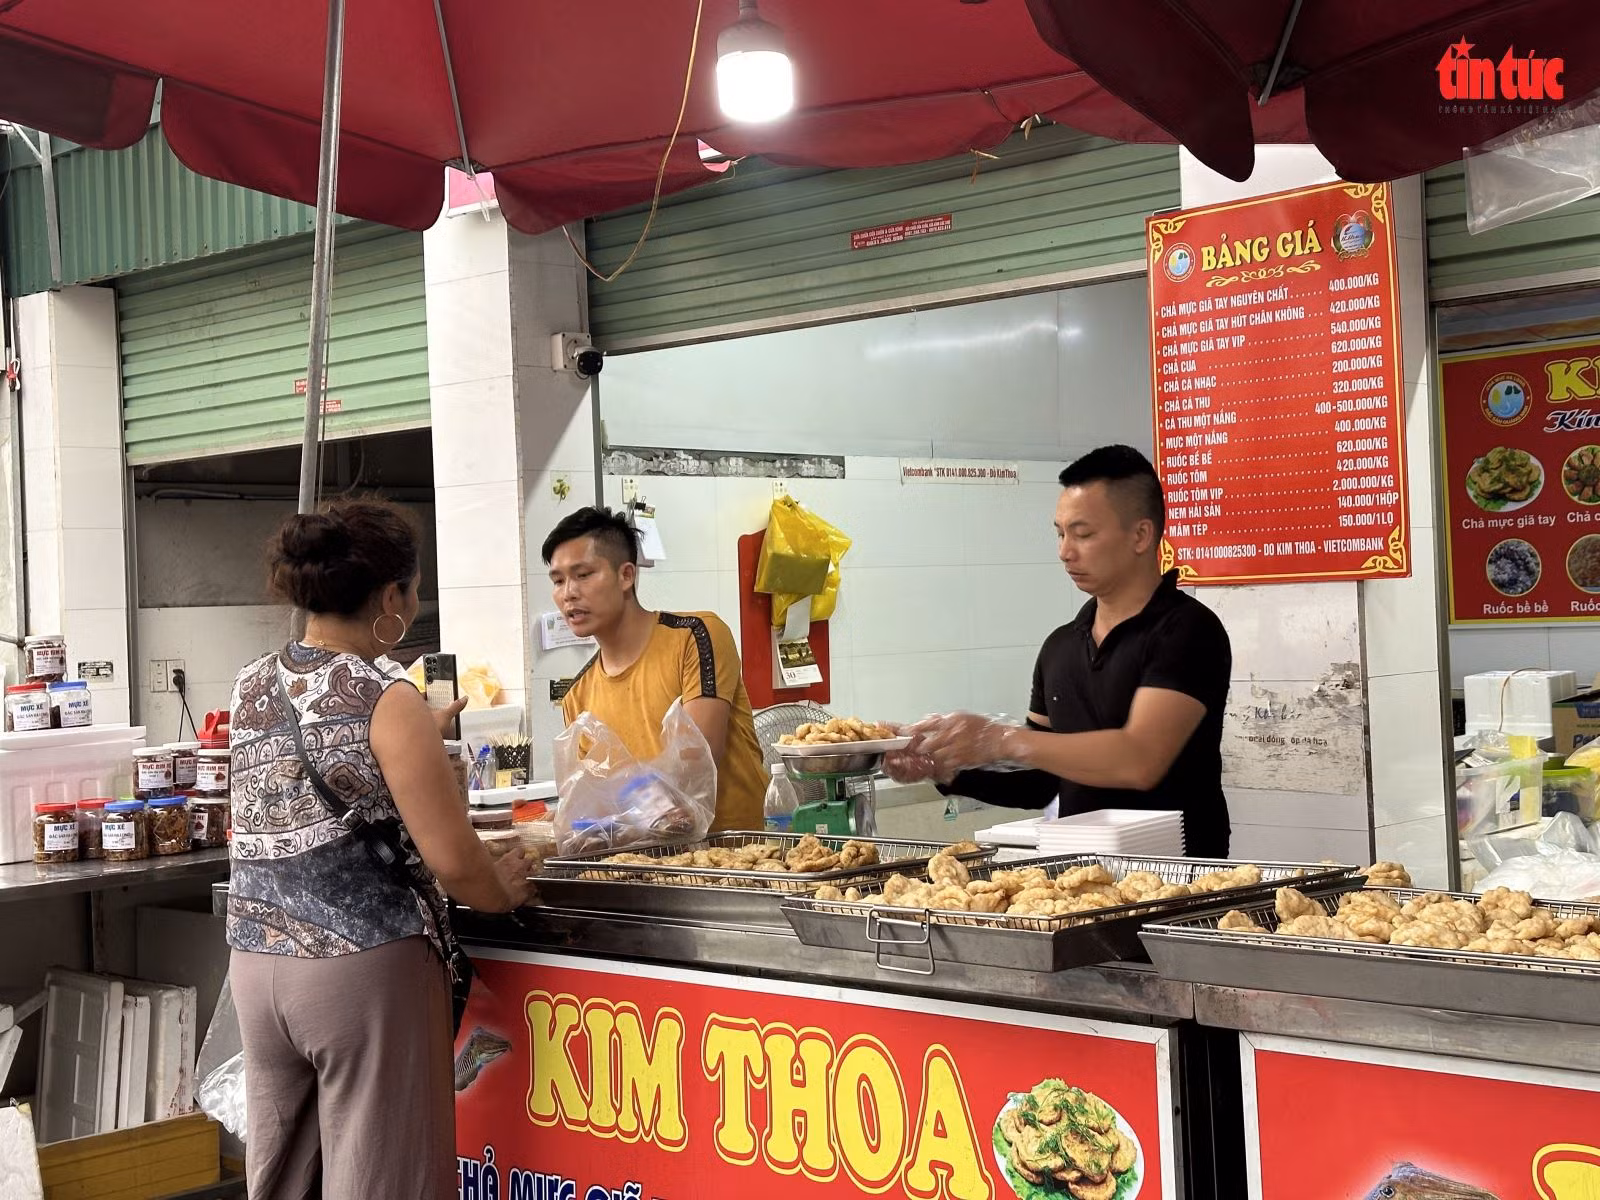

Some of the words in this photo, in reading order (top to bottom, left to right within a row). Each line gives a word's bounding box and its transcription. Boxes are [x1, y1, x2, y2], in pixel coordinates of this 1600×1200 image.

[1200, 233, 1271, 272] BẢNG
[1276, 220, 1322, 257] GIÁ
[1161, 301, 1176, 318] CHẢ
[1178, 300, 1197, 317] MỰC
[1214, 296, 1228, 309] TAY
[1230, 290, 1264, 308] NGUYÊN
[1267, 284, 1288, 302] CHẤT
[1328, 273, 1379, 292] 400.000/KG
[1162, 321, 1177, 338] CHẢ
[1180, 320, 1198, 337] MỰC
[1215, 317, 1229, 330] TAY
[1231, 313, 1247, 327] HÚT
[1249, 310, 1272, 326] CHÂN
[1275, 306, 1305, 322] KHÔNG
[1330, 295, 1380, 314] 420.000/KG
[1162, 341, 1178, 357] CHẢ
[1180, 340, 1198, 356] MỰC
[1216, 336, 1230, 350] TAY
[1232, 334, 1245, 348] VIP
[1330, 316, 1381, 335] 540.000/KG
[1163, 359, 1179, 375] CHẢ
[1181, 360, 1197, 374] CUA
[1331, 335, 1382, 354] 620.000/KG
[1164, 377, 1179, 393] CHẢ
[1195, 376, 1216, 391] NHẠC
[1332, 355, 1383, 374] 200.000/KG
[1164, 396, 1180, 413] CHẢ
[1195, 396, 1210, 408] THU
[1333, 376, 1384, 394] 320.000/KG
[1177, 415, 1192, 428] THU
[1194, 412, 1211, 429] MỘT
[1315, 395, 1388, 414] 400-500.000/KG
[1166, 436, 1183, 451] MỰC
[1186, 433, 1203, 449] MỘT
[1335, 416, 1386, 433] 400.000/KG
[1166, 452, 1187, 468] RUỐC
[1336, 437, 1388, 453] 620.000/KG
[1167, 469, 1188, 485] RUỐC
[1190, 469, 1208, 483] TÔM
[1336, 455, 1388, 472] 420.000/KG
[1168, 487, 1189, 503] RUỐC
[1190, 487, 1208, 501] TÔM
[1210, 488, 1224, 500] VIP
[1333, 475, 1394, 491] 2.000.000/KG
[1169, 507, 1186, 520] NEM
[1189, 502, 1202, 518] HẢI
[1204, 501, 1221, 517] SẢN
[1337, 490, 1399, 508] 140.000/1HỘP
[1462, 516, 1484, 529] Chả
[1487, 518, 1514, 530] mực
[1517, 514, 1534, 529] giã
[1538, 514, 1556, 526] tay
[1567, 511, 1590, 522] Chả
[1177, 547, 1194, 561] STK:
[1196, 544, 1256, 559] 0141000825300
[1277, 542, 1292, 555] KIM
[1295, 541, 1316, 554] THOA
[1324, 537, 1384, 553] VIETCOMBANK
[1483, 601, 1513, 614] Ruốc
[786, 671, 796, 680] 30
[524, 990, 688, 1152] KIM
[700, 1012, 994, 1200] THOA
[456, 1145, 500, 1200] HẢ
